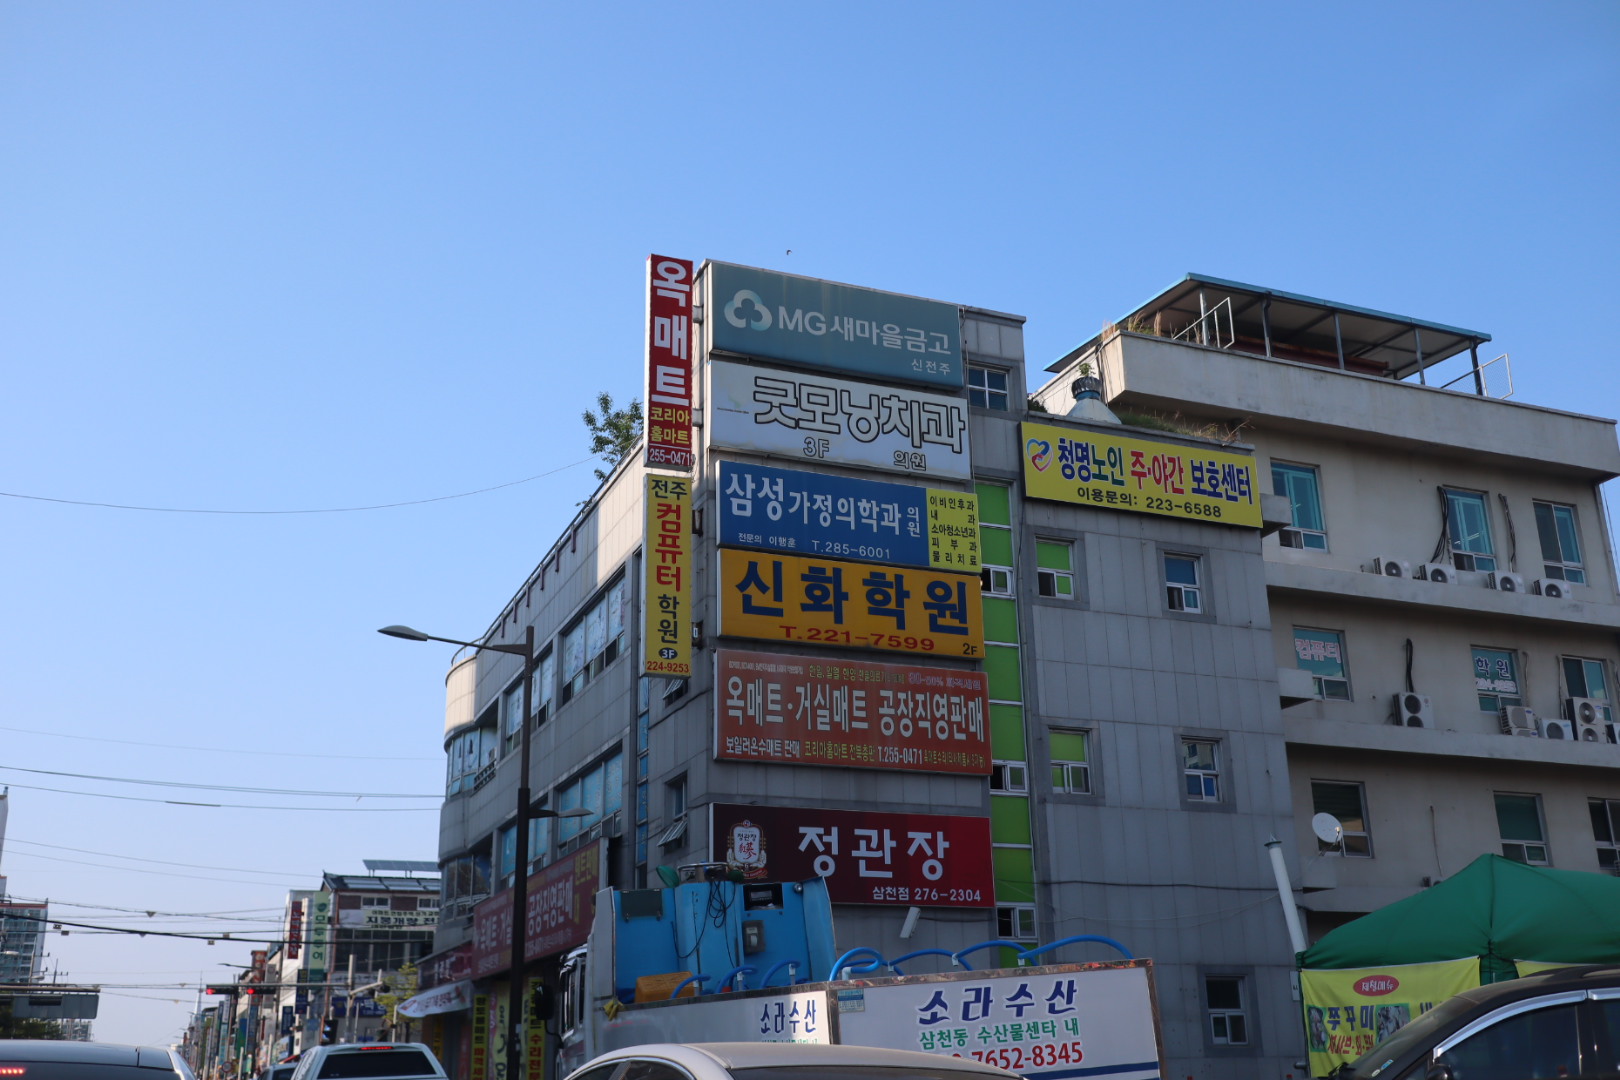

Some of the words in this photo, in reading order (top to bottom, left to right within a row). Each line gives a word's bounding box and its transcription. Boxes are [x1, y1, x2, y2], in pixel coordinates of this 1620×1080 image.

[651, 261, 690, 406] 옥매트
[911, 358, 951, 376] 신전주
[650, 406, 690, 426] 코리아
[753, 375, 966, 454] 굿모닝치과
[650, 426, 690, 446] 홈마트
[649, 448, 692, 466] 255-0471
[803, 437, 830, 459] 3F
[893, 450, 927, 471] 의원
[651, 479, 688, 500] 전주
[1190, 459, 1253, 505] 보호센터
[930, 496, 975, 511] 이비인후과
[1077, 487, 1137, 506] 이용문의:
[1146, 497, 1222, 518] 223-6588
[737, 532, 762, 545] 전문의
[931, 523, 976, 539] 소아청소년과
[655, 502, 683, 592] 컴퓨터
[812, 540, 891, 560] T.285-6001
[735, 560, 969, 635] 신화학원
[657, 594, 680, 645] 학원
[779, 625, 935, 651] T.221-7599
[962, 642, 978, 656] 2F
[661, 648, 676, 660] 3F
[1294, 638, 1341, 663] 컴퓨터
[647, 659, 690, 674] 224-9253
[879, 689, 984, 742] 공장직영판매
[726, 736, 783, 757] 보일러온수매트
[784, 740, 800, 758] 판매
[805, 740, 848, 759] 코리아홈마트
[798, 826, 949, 881] 정관장
[528, 873, 574, 936] 공장직영판매
[872, 886, 909, 900] 삼천점
[914, 888, 981, 902] 276-2304
[1361, 979, 1395, 992] 제철메뉴
[917, 978, 1078, 1025] 소라수산
[760, 999, 816, 1034] 소라수산
[919, 1027, 969, 1050] 삼천동
[977, 1019, 1057, 1045] 수산물센타
[1064, 1017, 1080, 1037] 내
